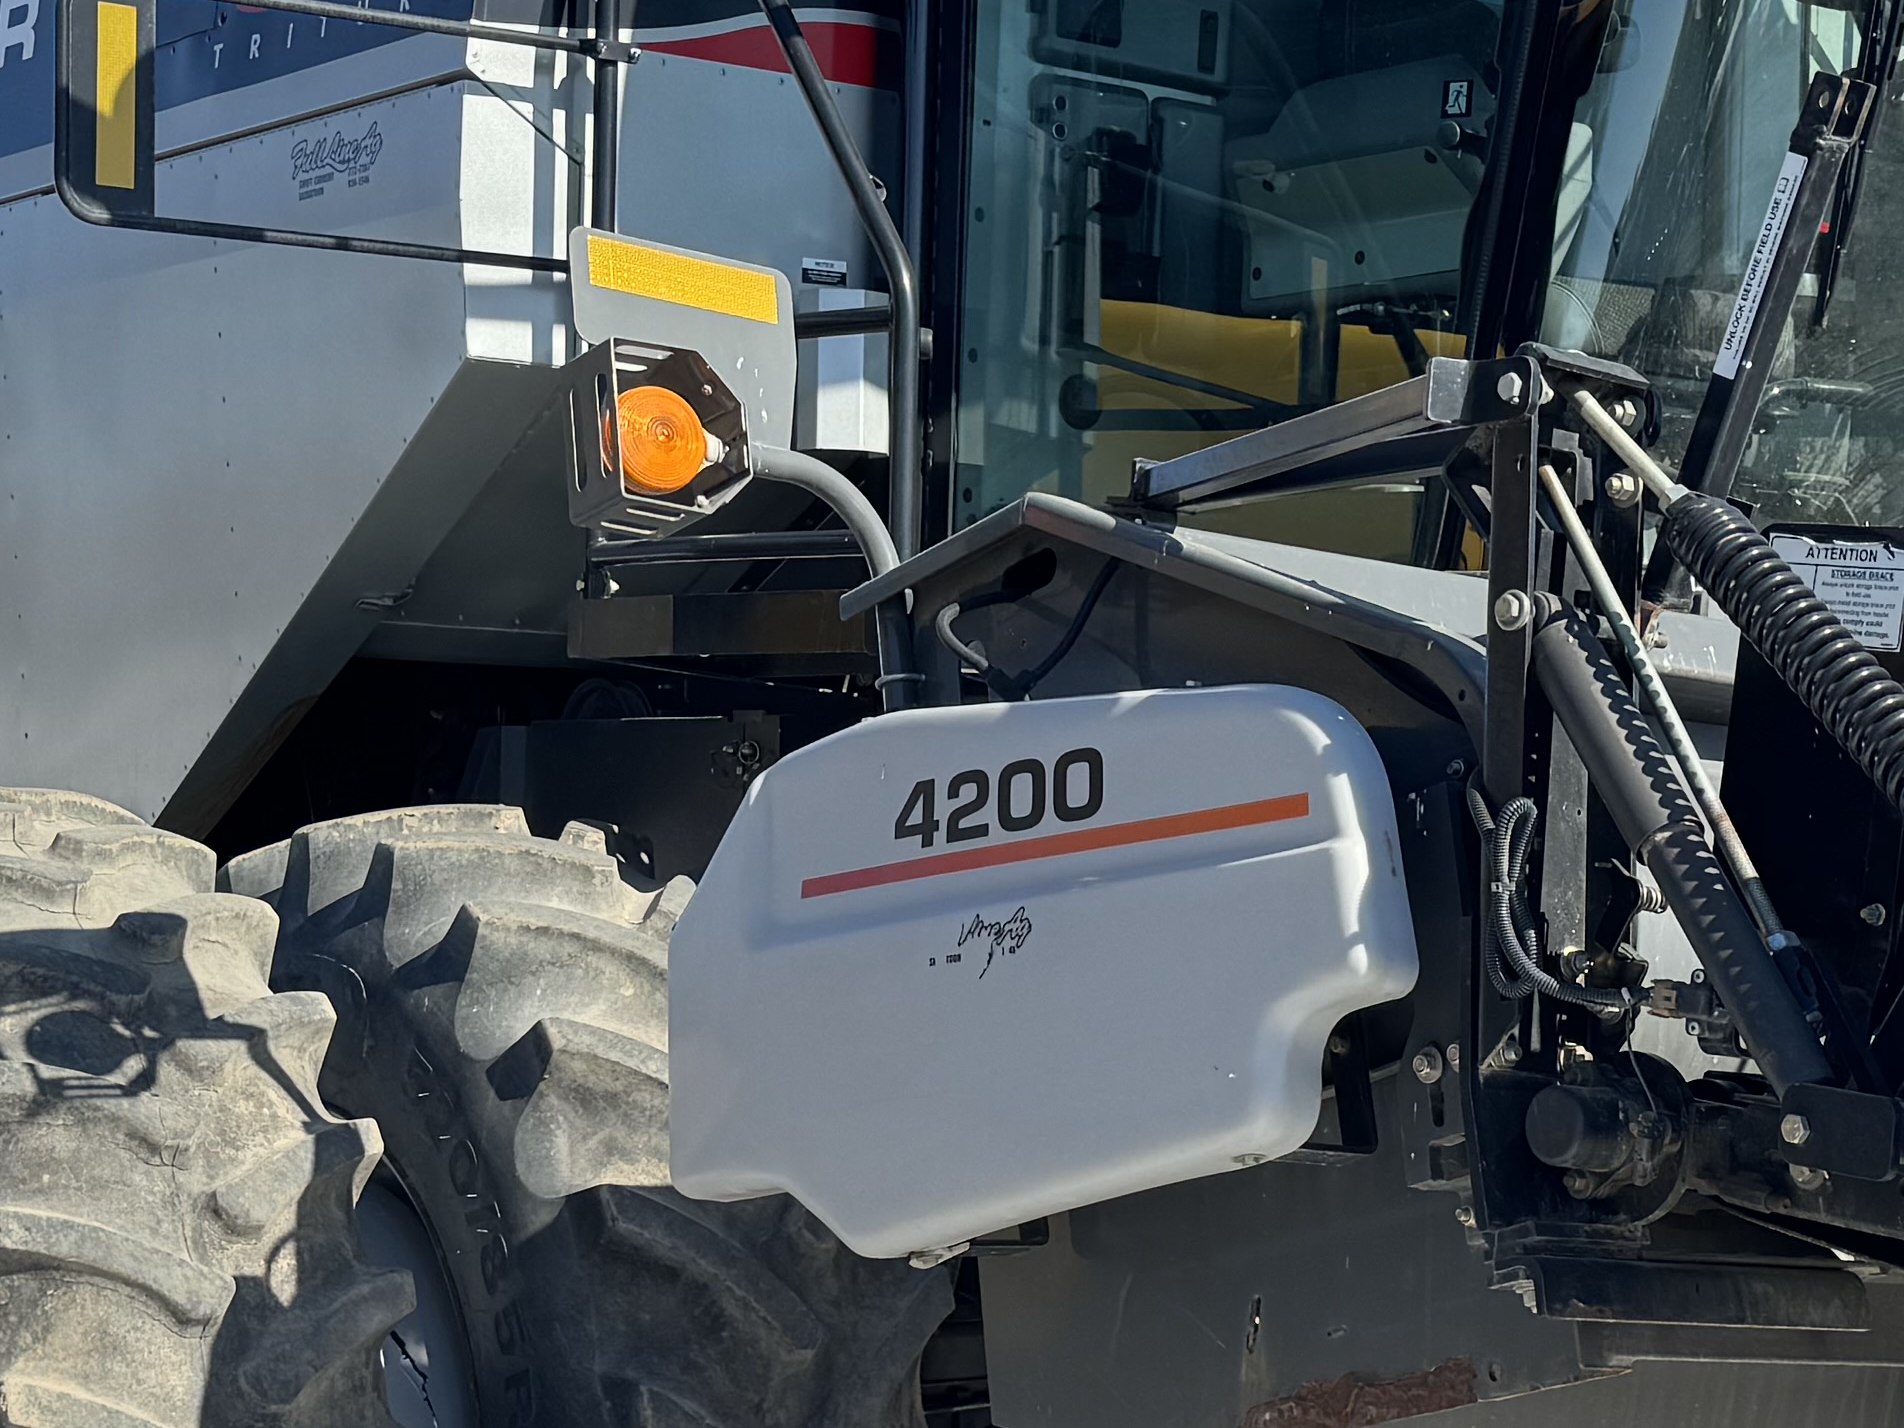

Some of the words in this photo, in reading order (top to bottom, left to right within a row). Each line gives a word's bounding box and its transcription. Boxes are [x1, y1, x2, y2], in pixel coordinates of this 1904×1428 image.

[1724, 304, 1746, 350] UNLOCK
[1742, 257, 1761, 301] BEFORE
[1758, 223, 1773, 258] FIELD
[1770, 197, 1782, 221] USE
[1805, 546, 1878, 562] ATTENTION
[893, 747, 1105, 849] 4200
